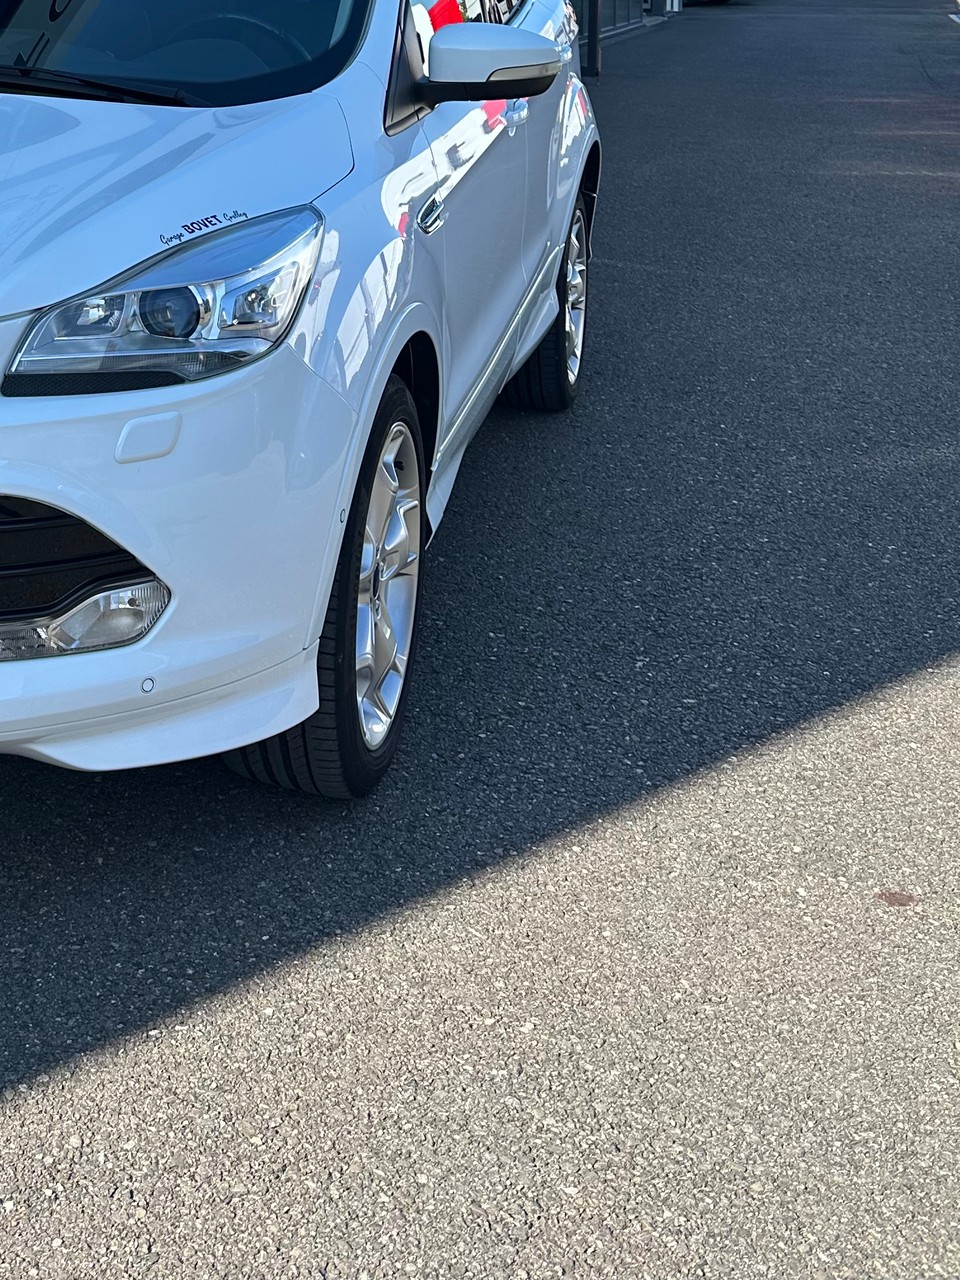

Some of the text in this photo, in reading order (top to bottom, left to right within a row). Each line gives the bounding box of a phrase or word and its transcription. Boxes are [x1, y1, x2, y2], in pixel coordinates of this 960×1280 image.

[159, 210, 249, 246] Garage BOVET Grolley
